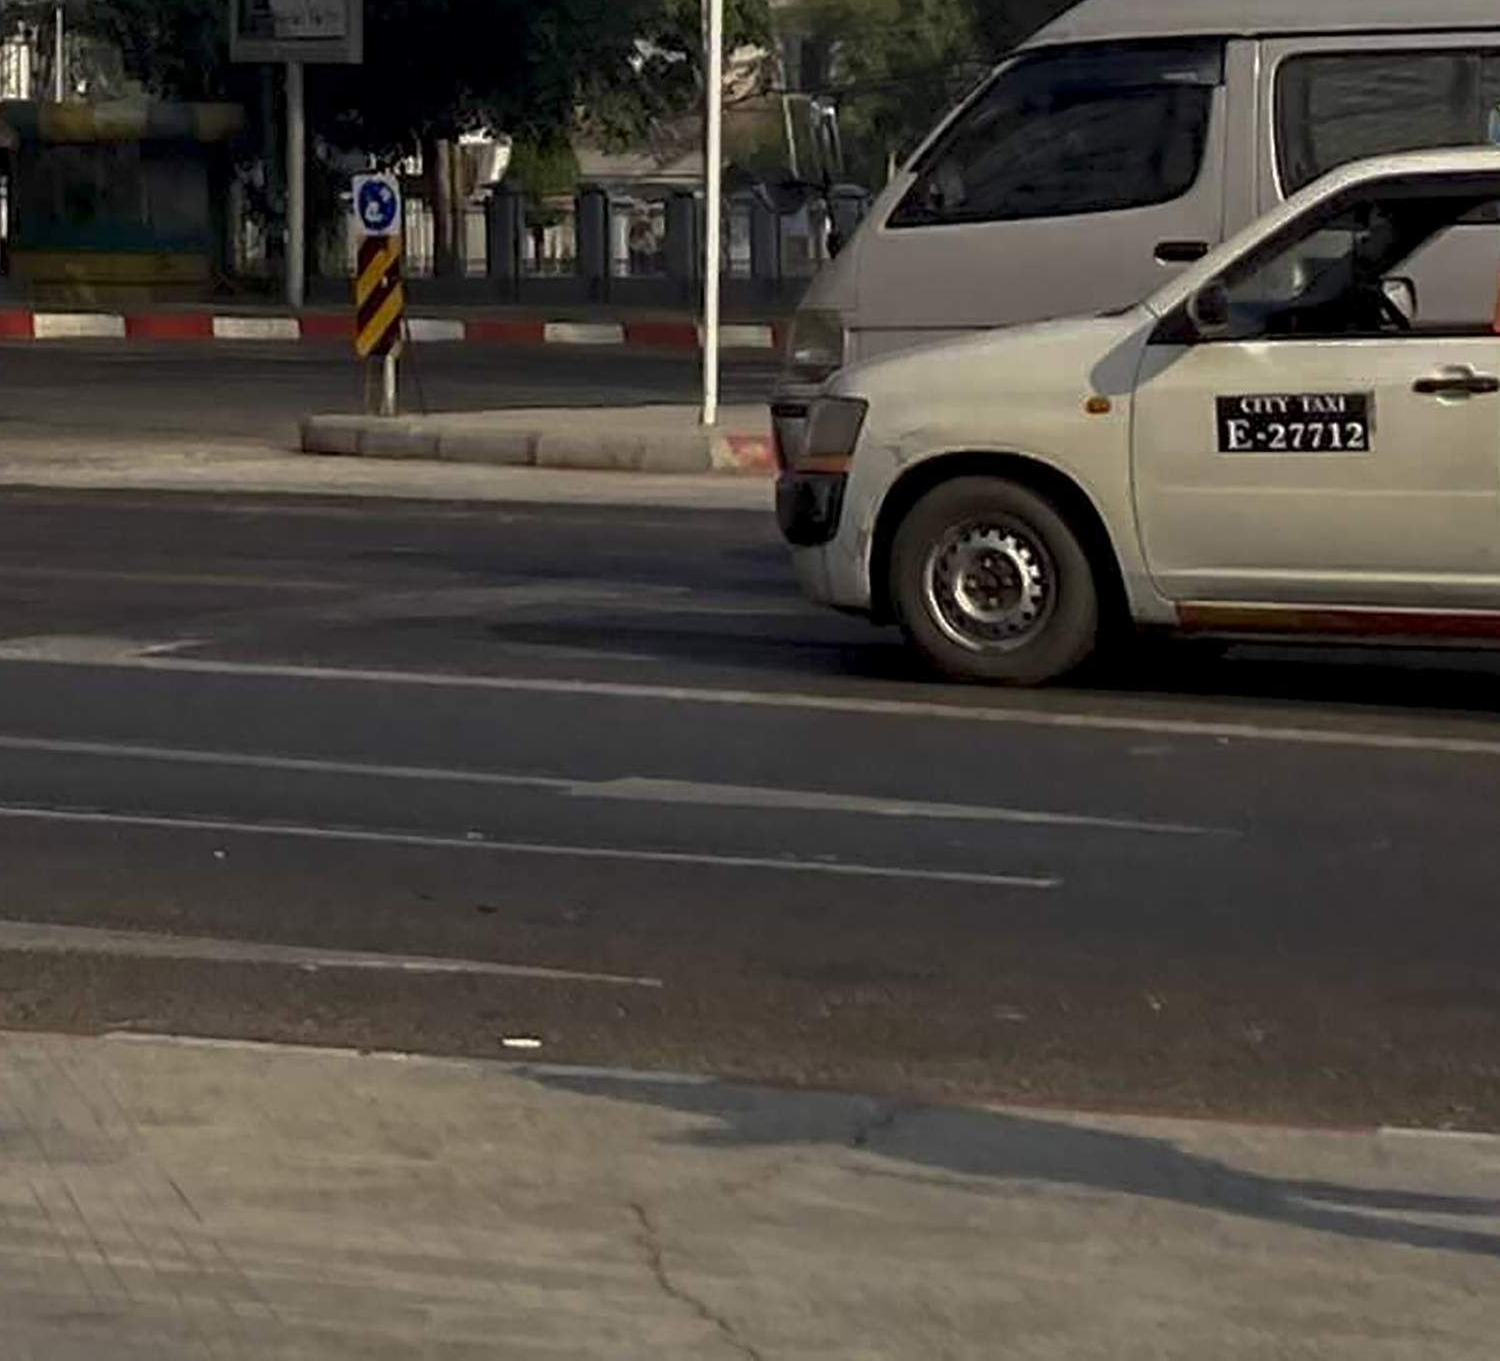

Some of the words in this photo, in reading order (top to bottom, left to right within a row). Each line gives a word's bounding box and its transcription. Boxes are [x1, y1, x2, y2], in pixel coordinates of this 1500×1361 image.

[1240, 395, 1289, 414] CITY
[1299, 394, 1346, 414] TAXI
[1226, 418, 1365, 450] E-27712
